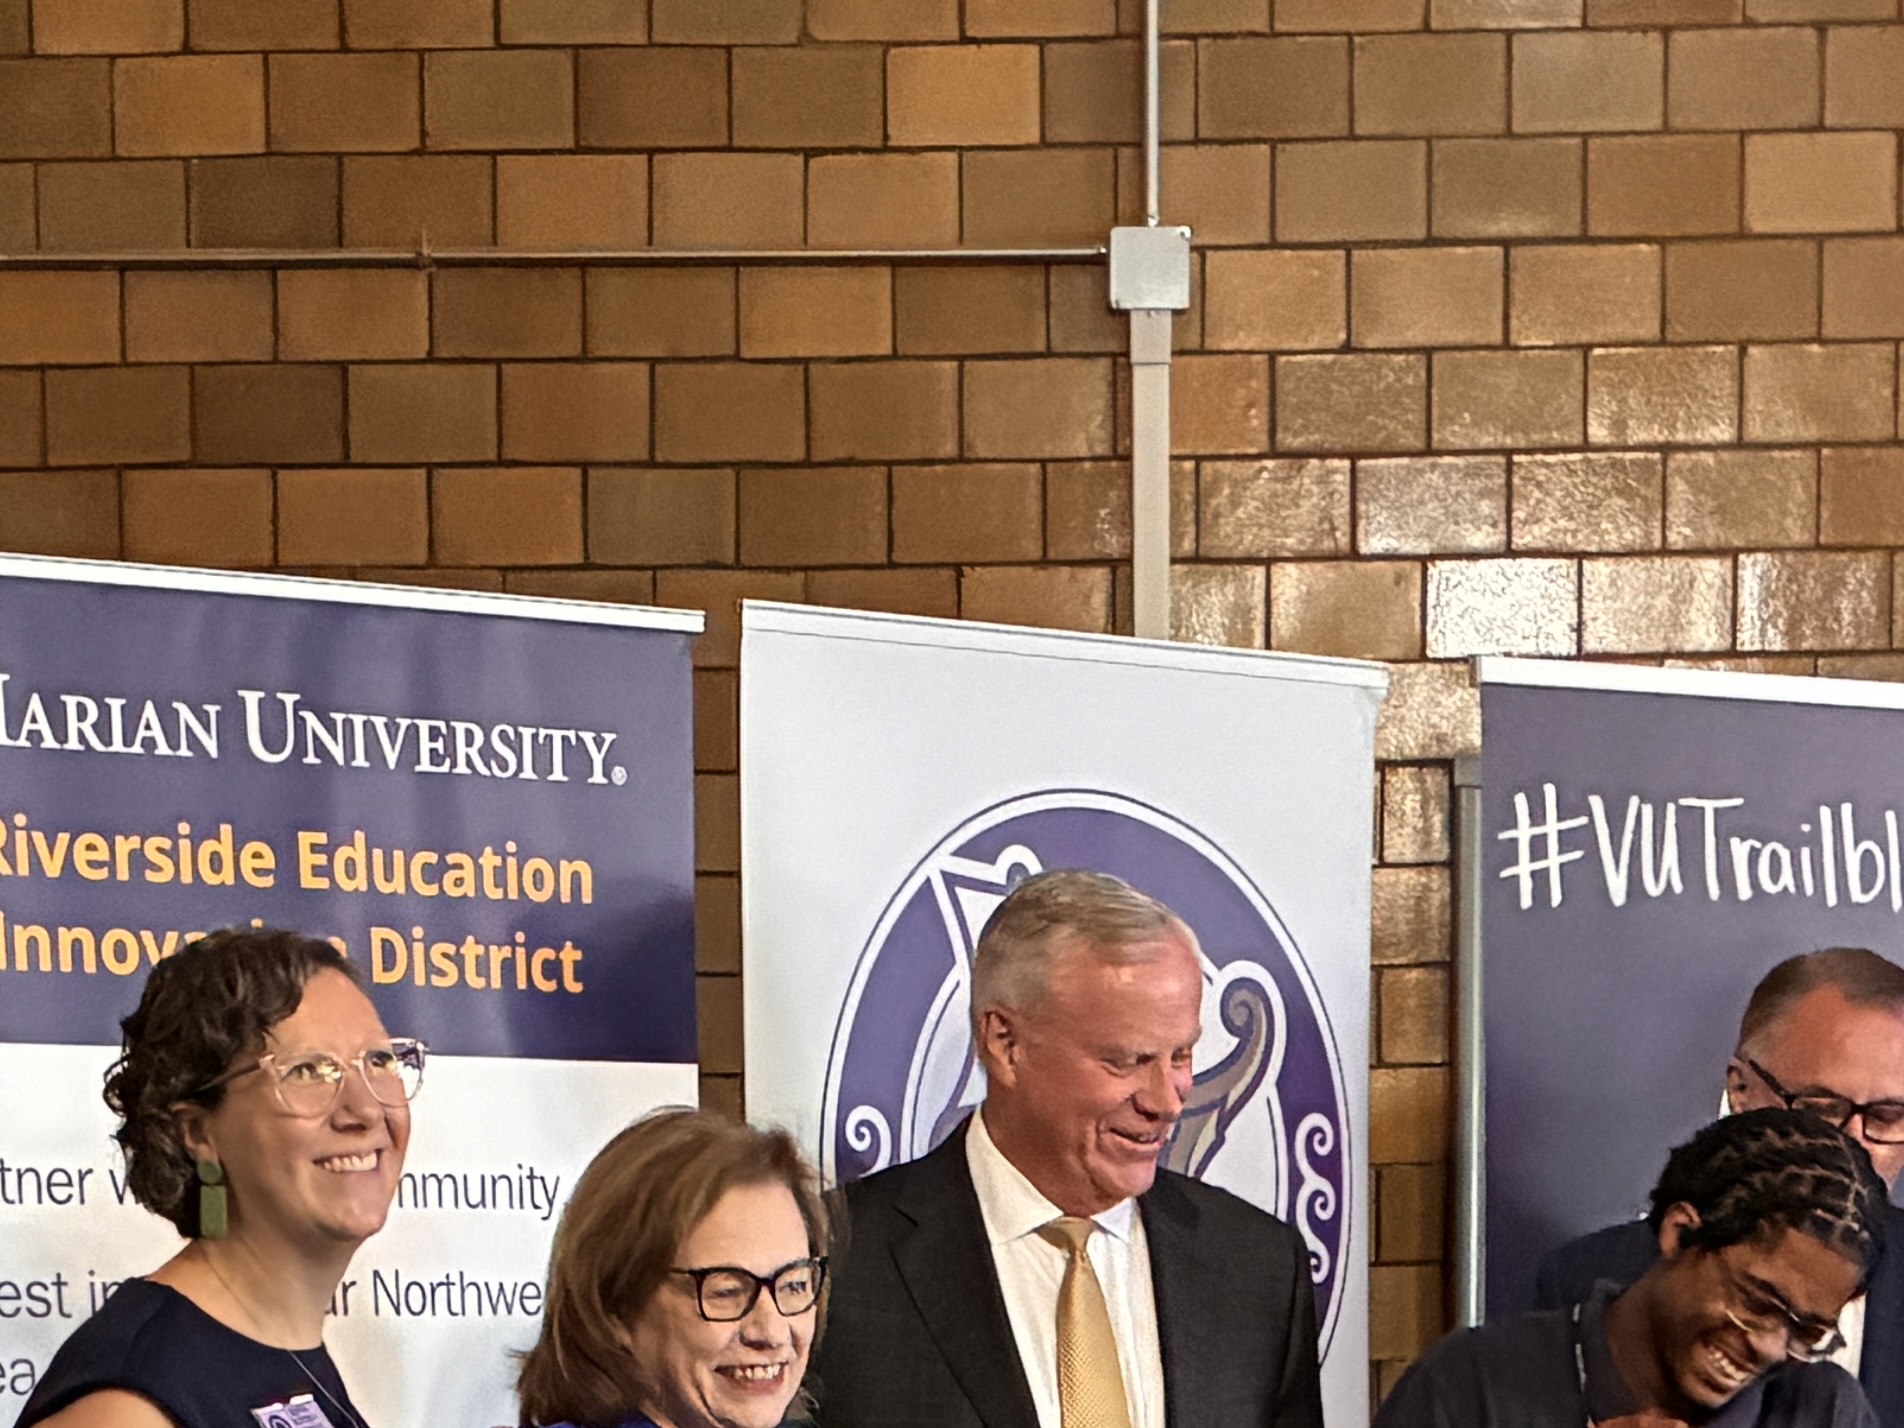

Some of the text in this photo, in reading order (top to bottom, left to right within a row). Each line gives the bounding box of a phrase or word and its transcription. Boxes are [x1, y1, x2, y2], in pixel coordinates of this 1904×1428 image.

[296, 830, 594, 905] Education
[368, 926, 585, 994] District
[372, 1268, 543, 1317] Northwe
